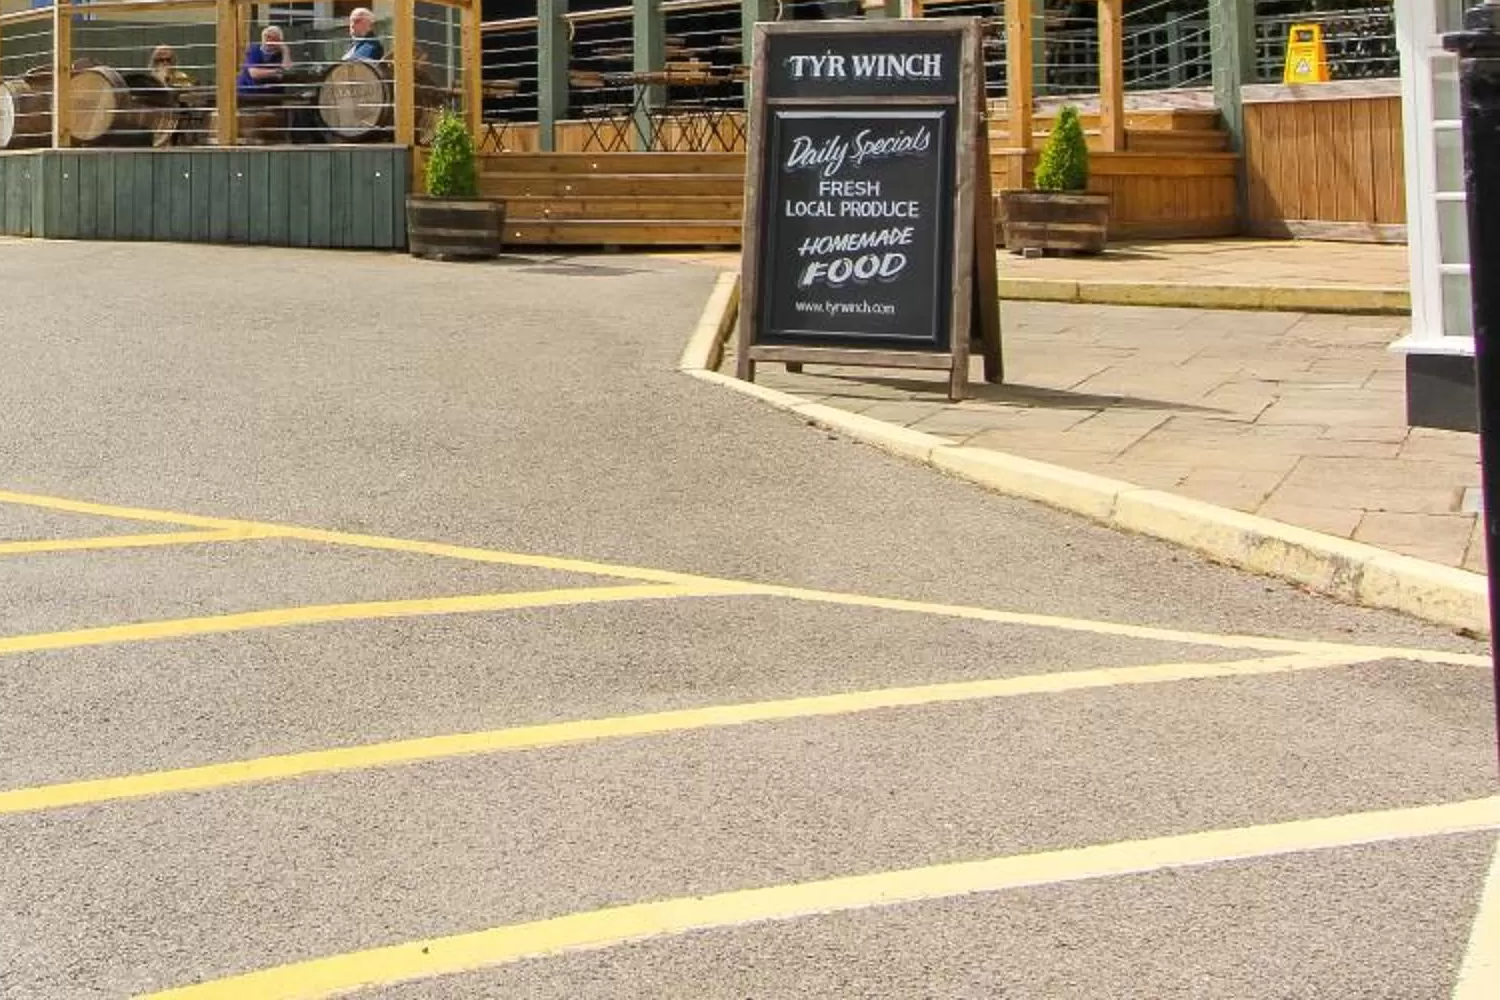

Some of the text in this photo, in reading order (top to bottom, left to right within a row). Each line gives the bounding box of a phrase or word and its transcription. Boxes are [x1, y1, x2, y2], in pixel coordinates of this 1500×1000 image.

[851, 53, 943, 78] WINCH
[786, 125, 931, 177] Daily Specials
[819, 181, 881, 197] FRESH
[785, 200, 920, 218] LOCAL PRODUCE
[798, 226, 915, 256] HOMEMADE
[801, 253, 907, 286] FOOD
